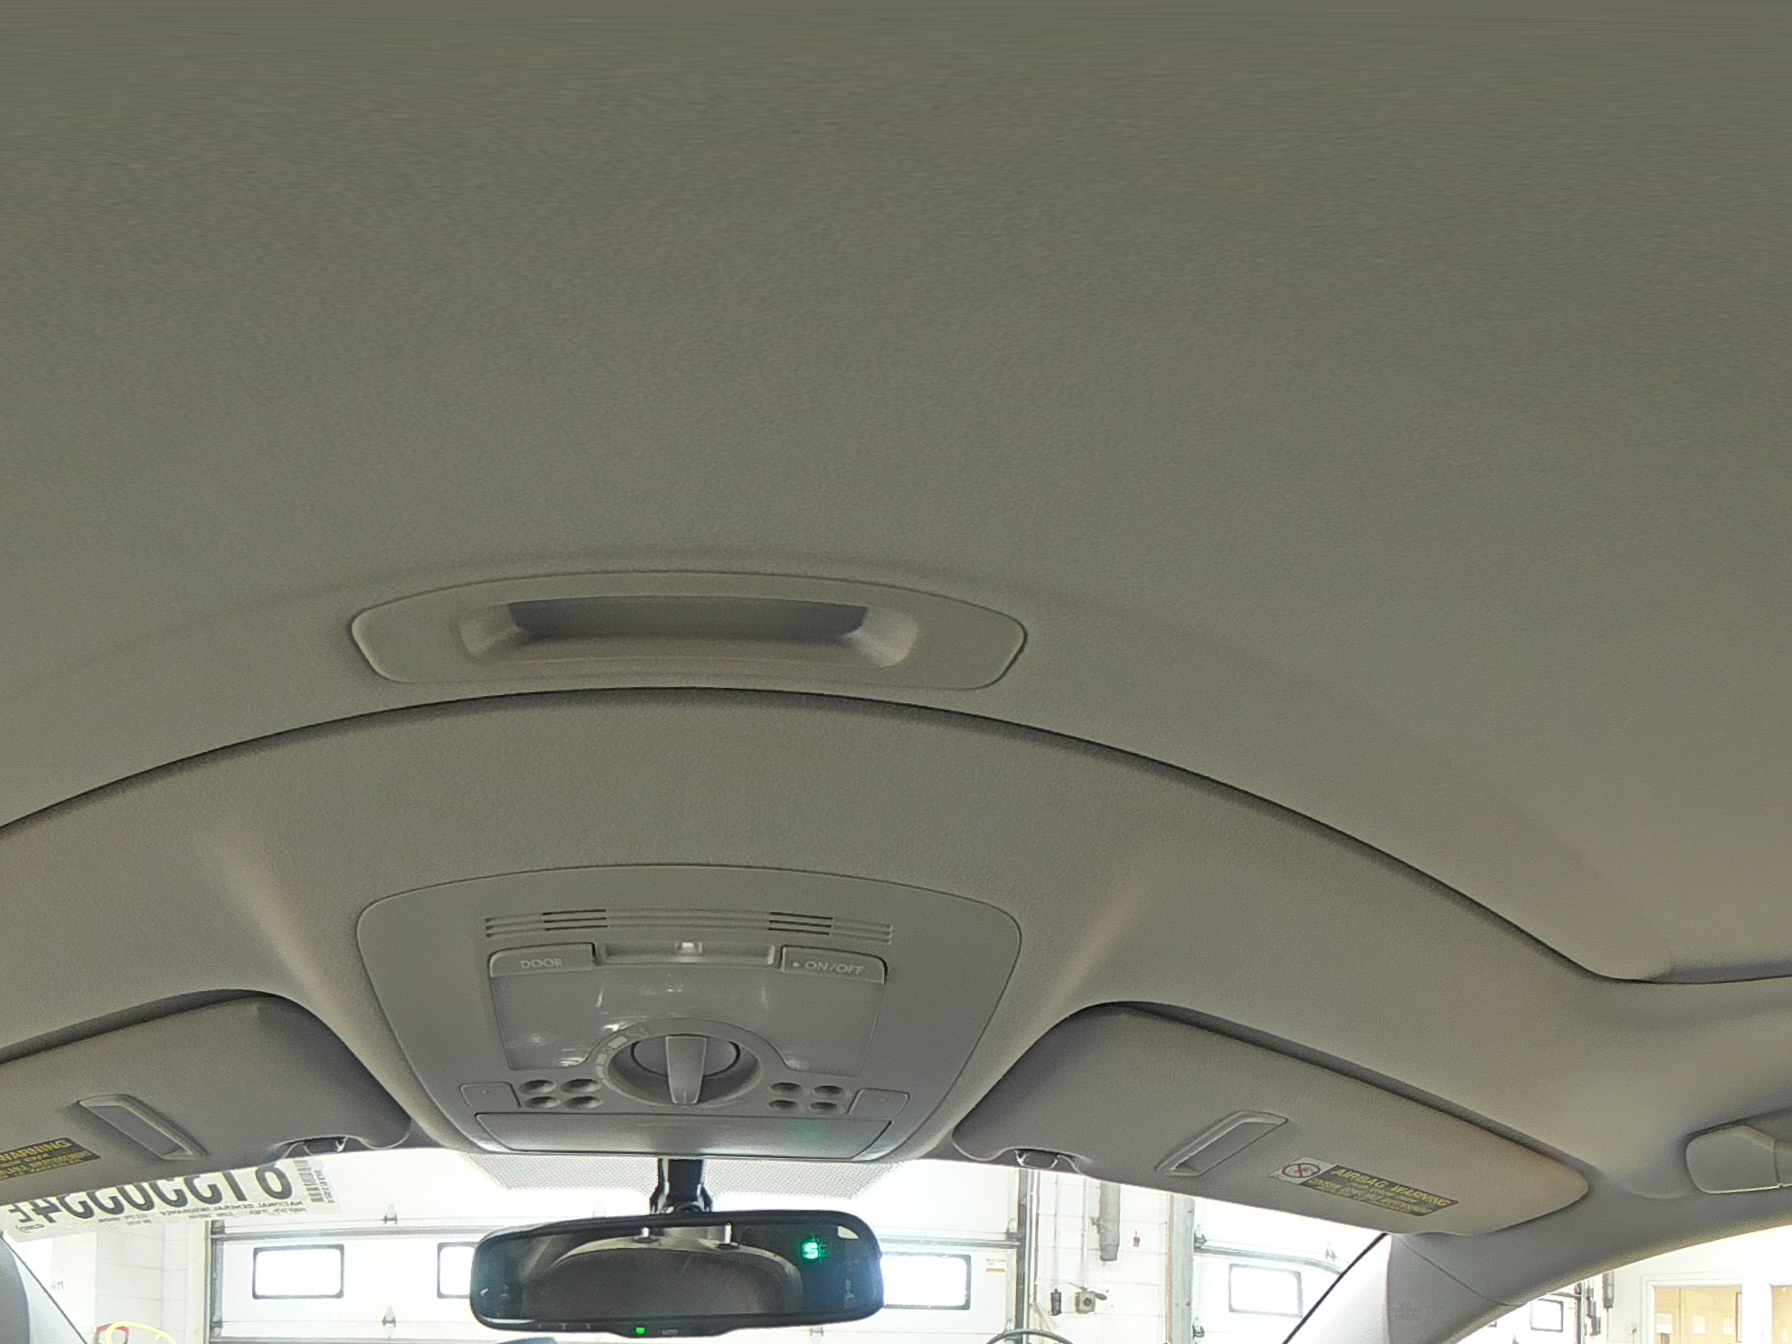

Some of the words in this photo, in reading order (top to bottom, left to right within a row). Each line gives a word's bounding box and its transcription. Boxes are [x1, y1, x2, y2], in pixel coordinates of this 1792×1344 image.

[519, 958, 563, 969] DOOR
[804, 961, 864, 975] ON/OFF
[1331, 1168, 1388, 1189] AIRBAG
[1390, 1184, 1451, 1207] WARNING
